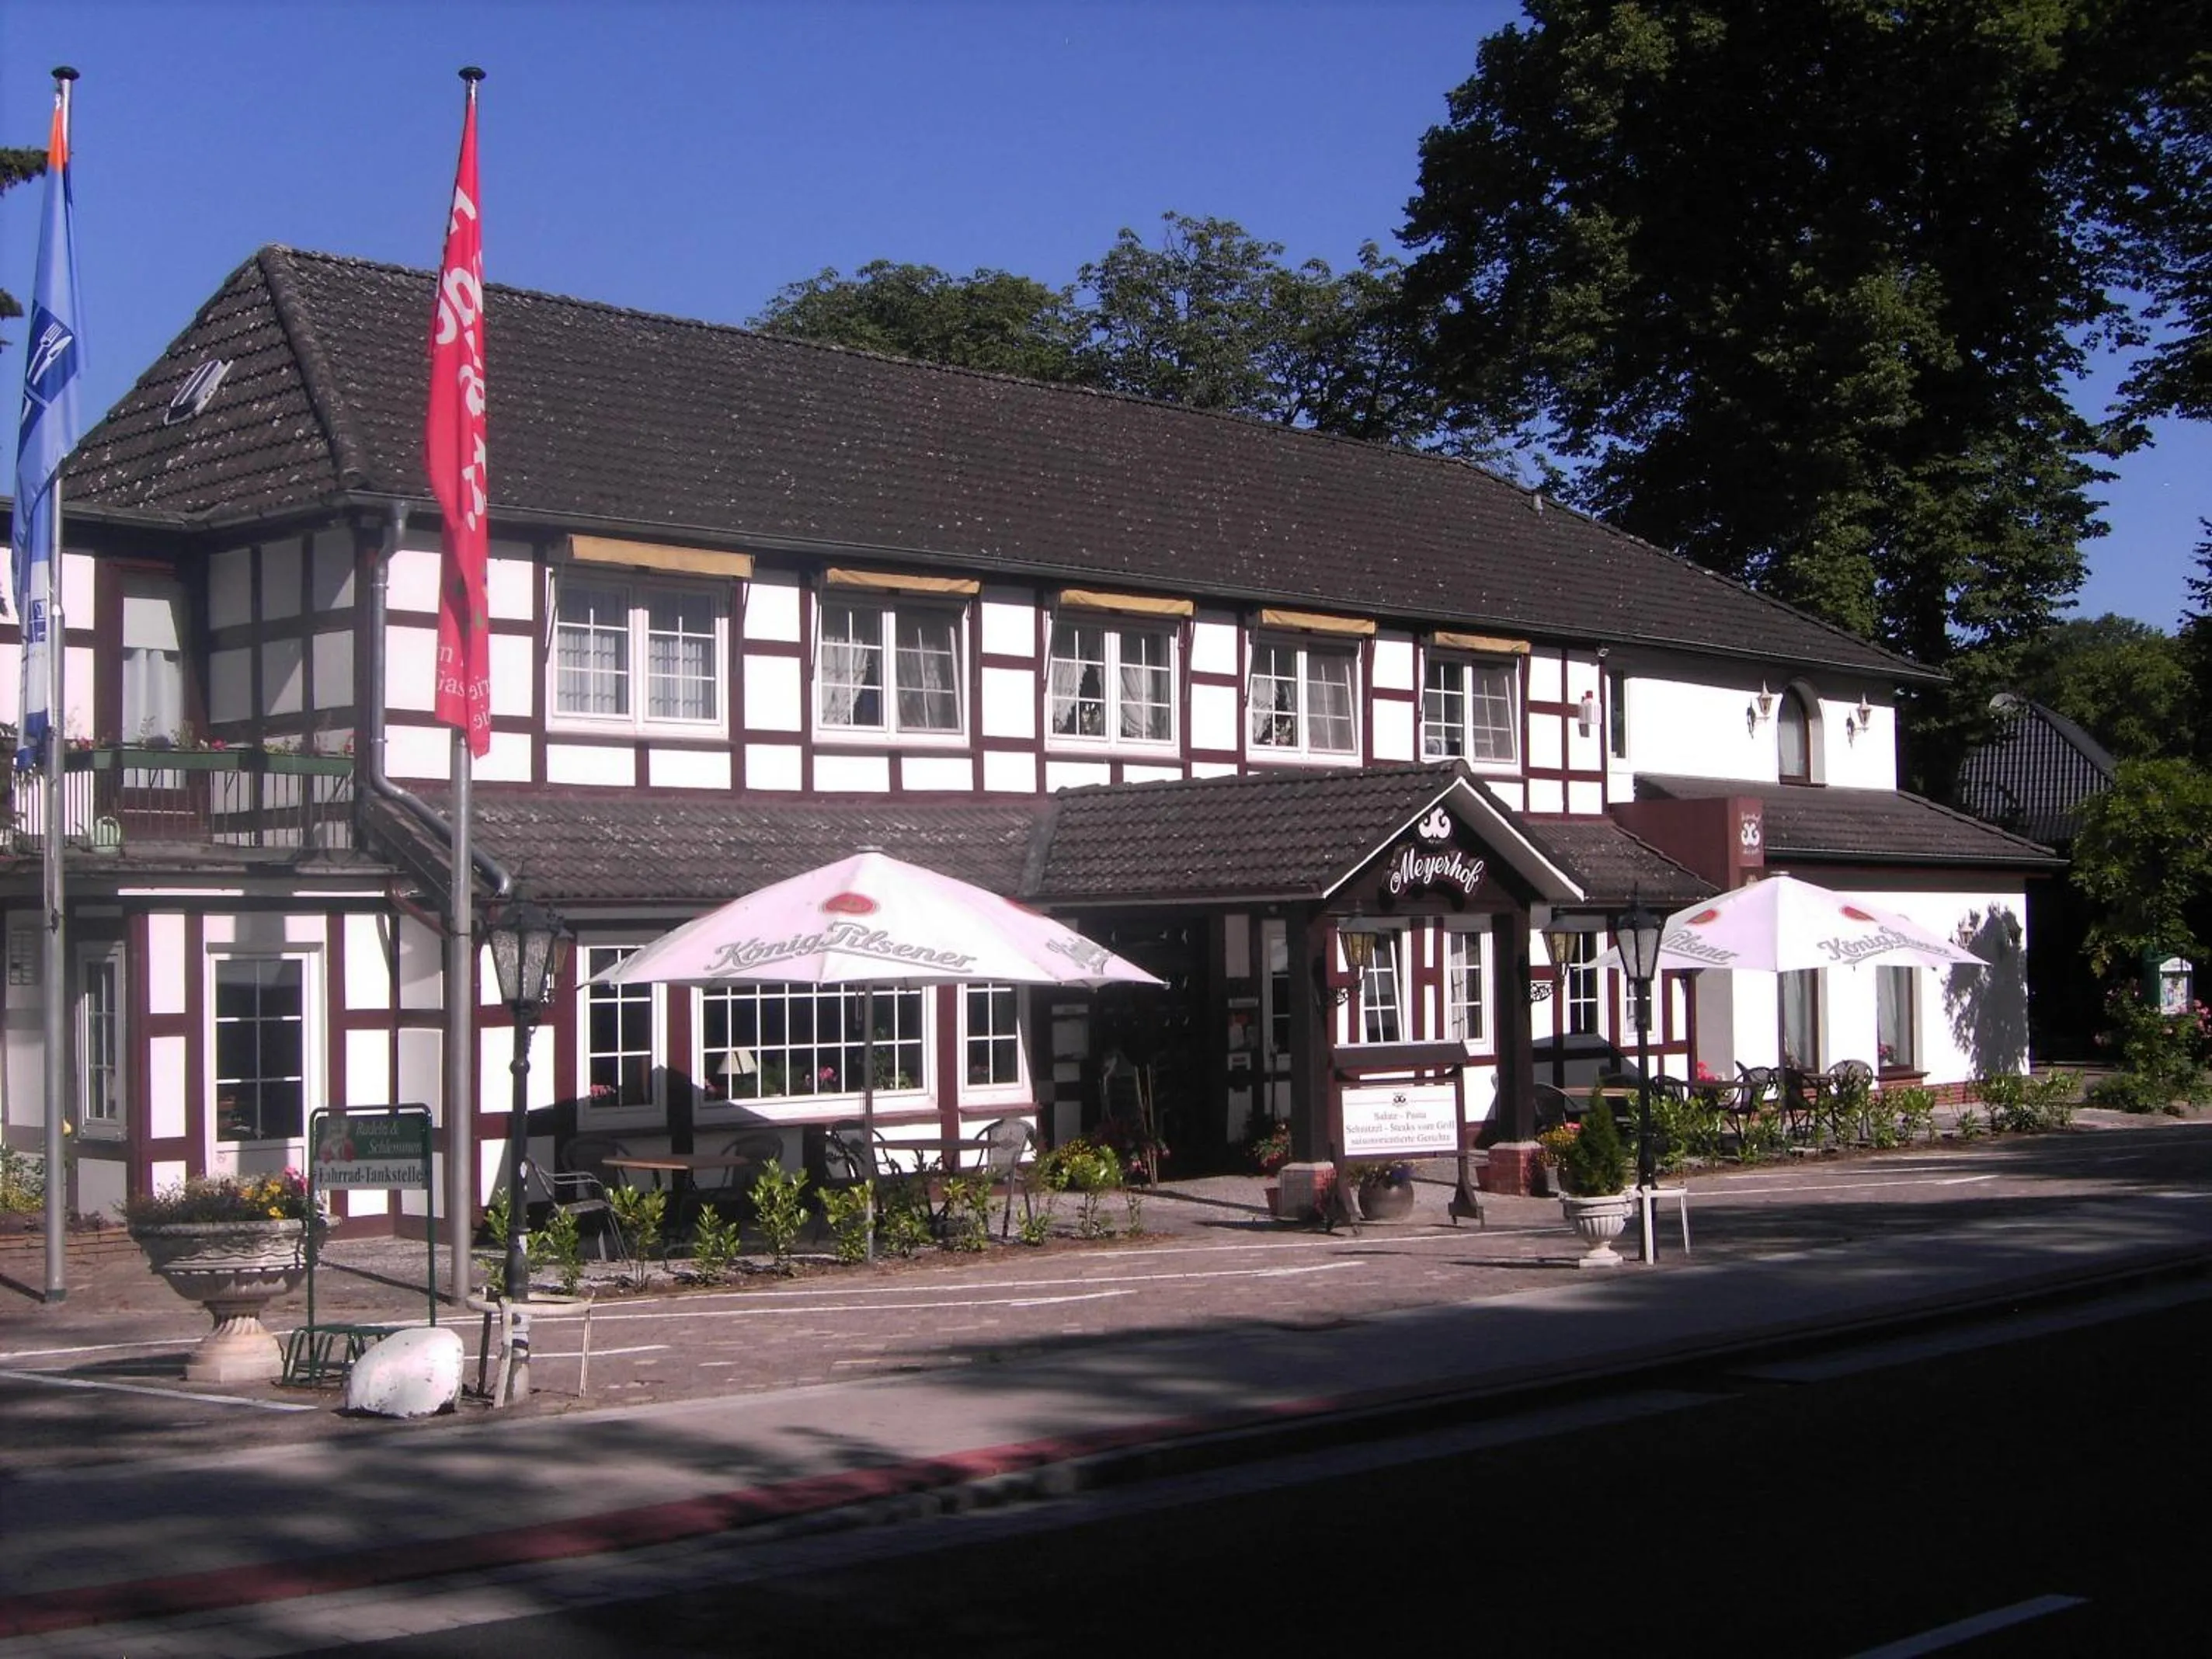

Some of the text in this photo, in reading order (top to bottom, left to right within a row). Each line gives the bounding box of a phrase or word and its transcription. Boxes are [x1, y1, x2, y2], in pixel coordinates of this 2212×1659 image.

[1390, 847, 1484, 894] Meyerhof
[704, 921, 977, 970] König Pilsener
[1817, 934, 1894, 961] König
